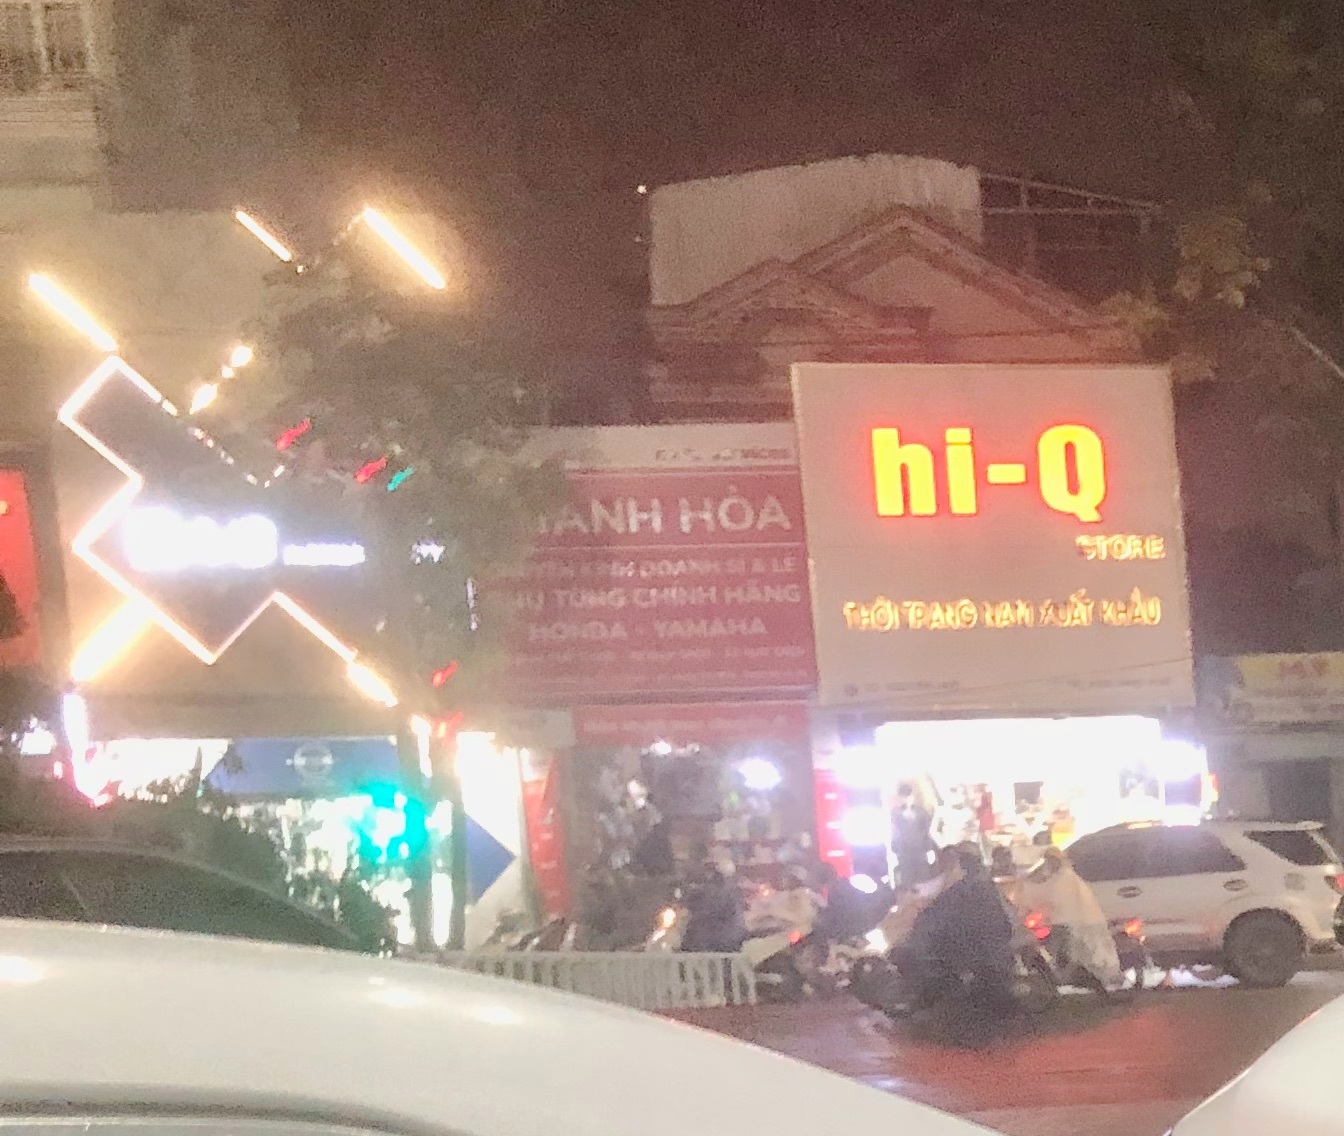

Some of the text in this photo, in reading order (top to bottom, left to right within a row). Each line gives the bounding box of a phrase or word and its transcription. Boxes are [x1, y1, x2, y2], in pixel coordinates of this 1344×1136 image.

[871, 424, 1107, 523] hi-Q
[1075, 534, 1166, 560] STORE
[653, 617, 768, 638] YAMAHA
